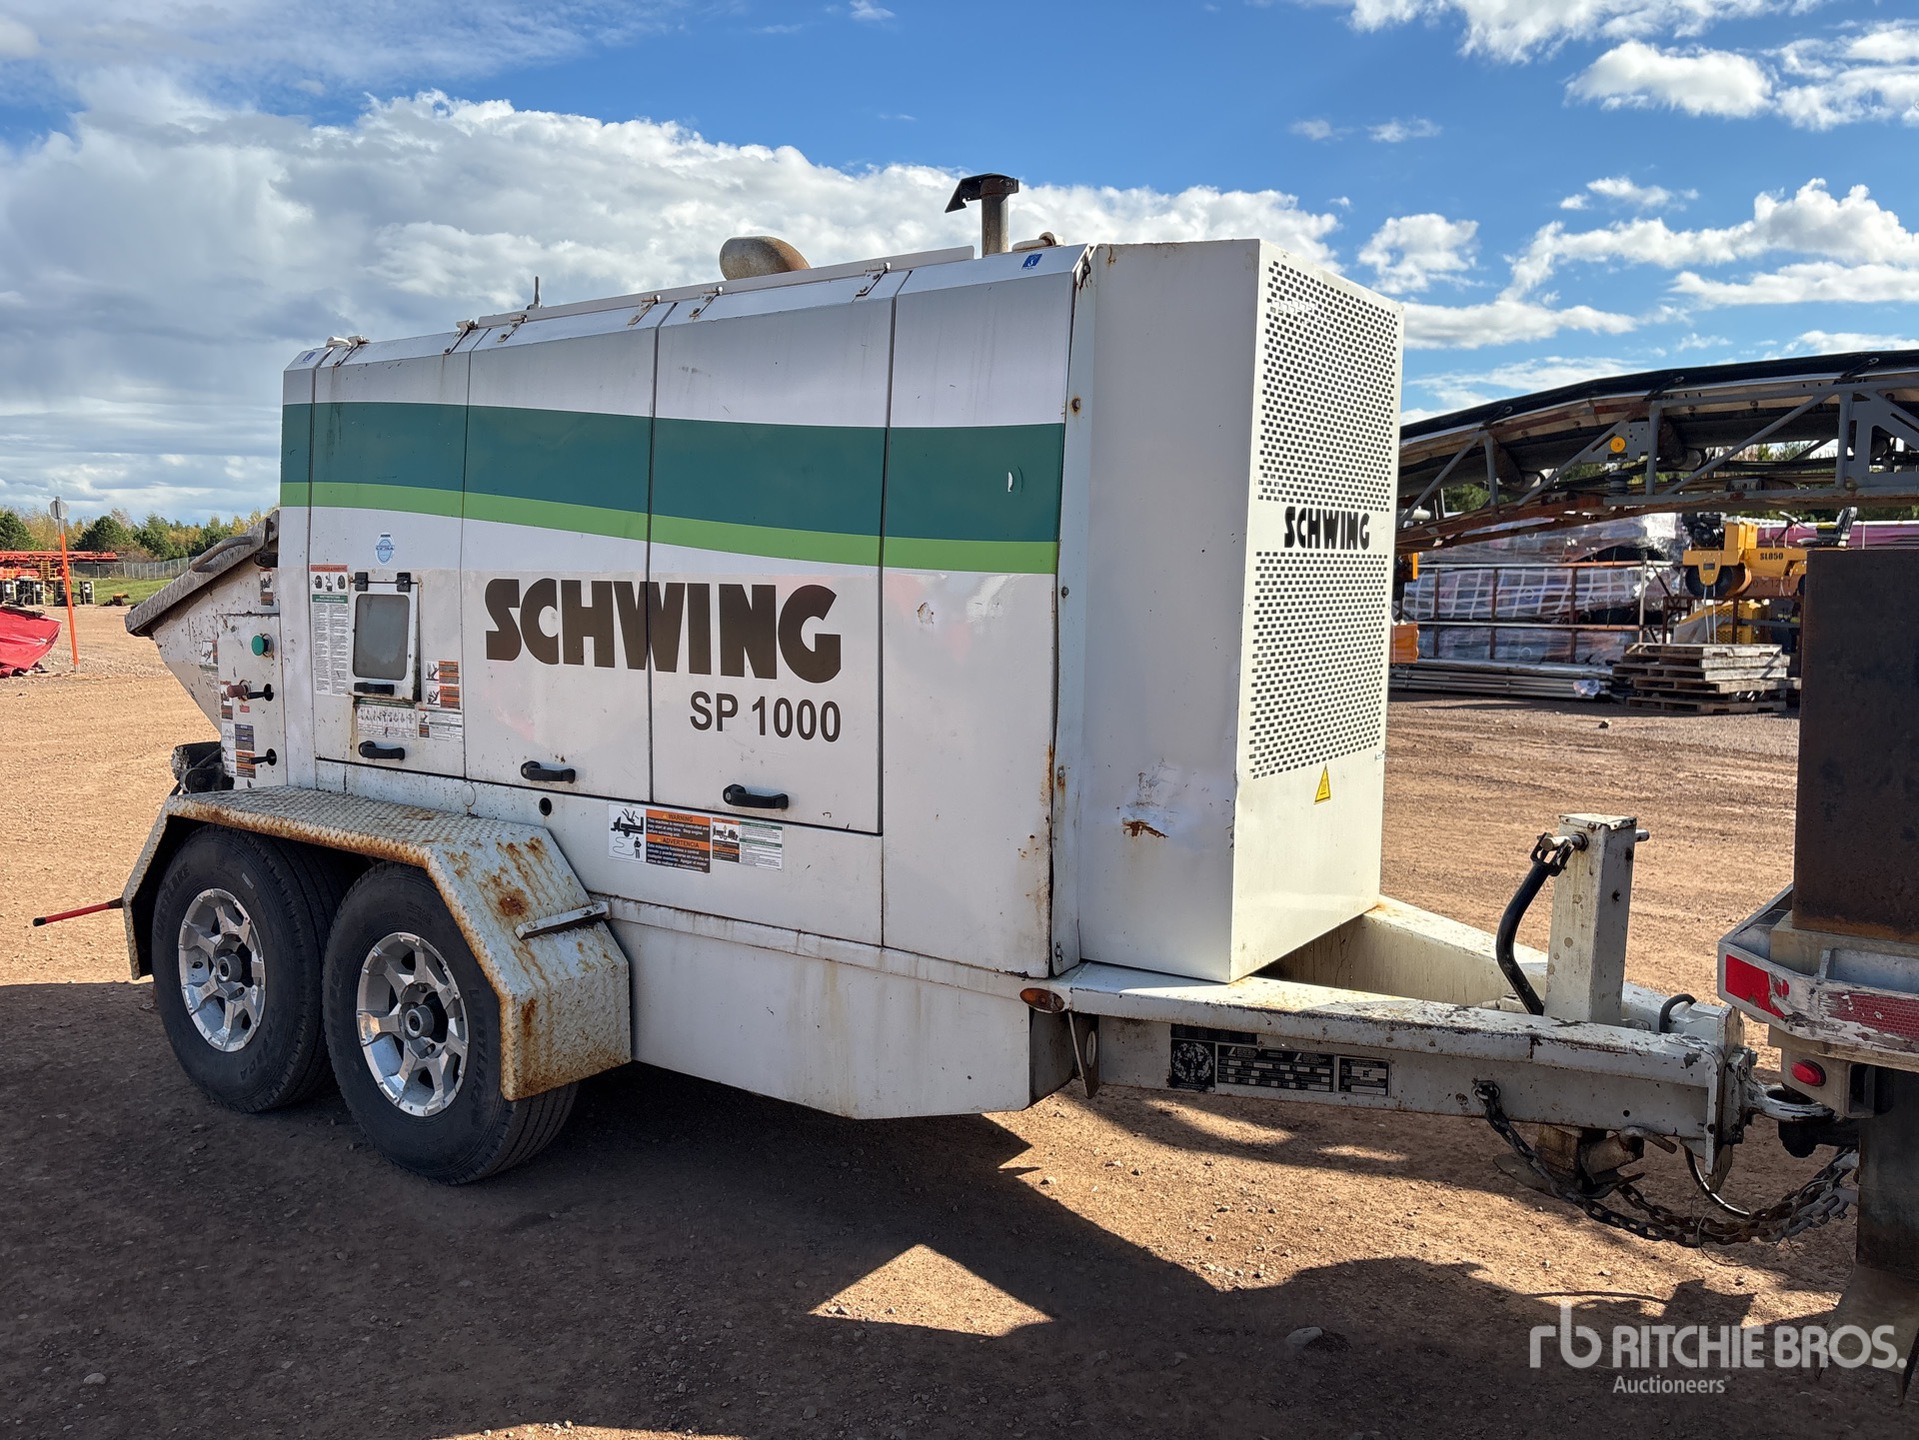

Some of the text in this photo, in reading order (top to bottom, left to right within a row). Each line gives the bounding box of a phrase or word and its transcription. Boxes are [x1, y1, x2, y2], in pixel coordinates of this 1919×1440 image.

[1284, 506, 1370, 550] SCHWING
[485, 577, 842, 684] SCHWING
[690, 690, 842, 743] SP 1000
[669, 814, 694, 822] WARNING
[662, 837, 700, 848] ADVERTENCIA
